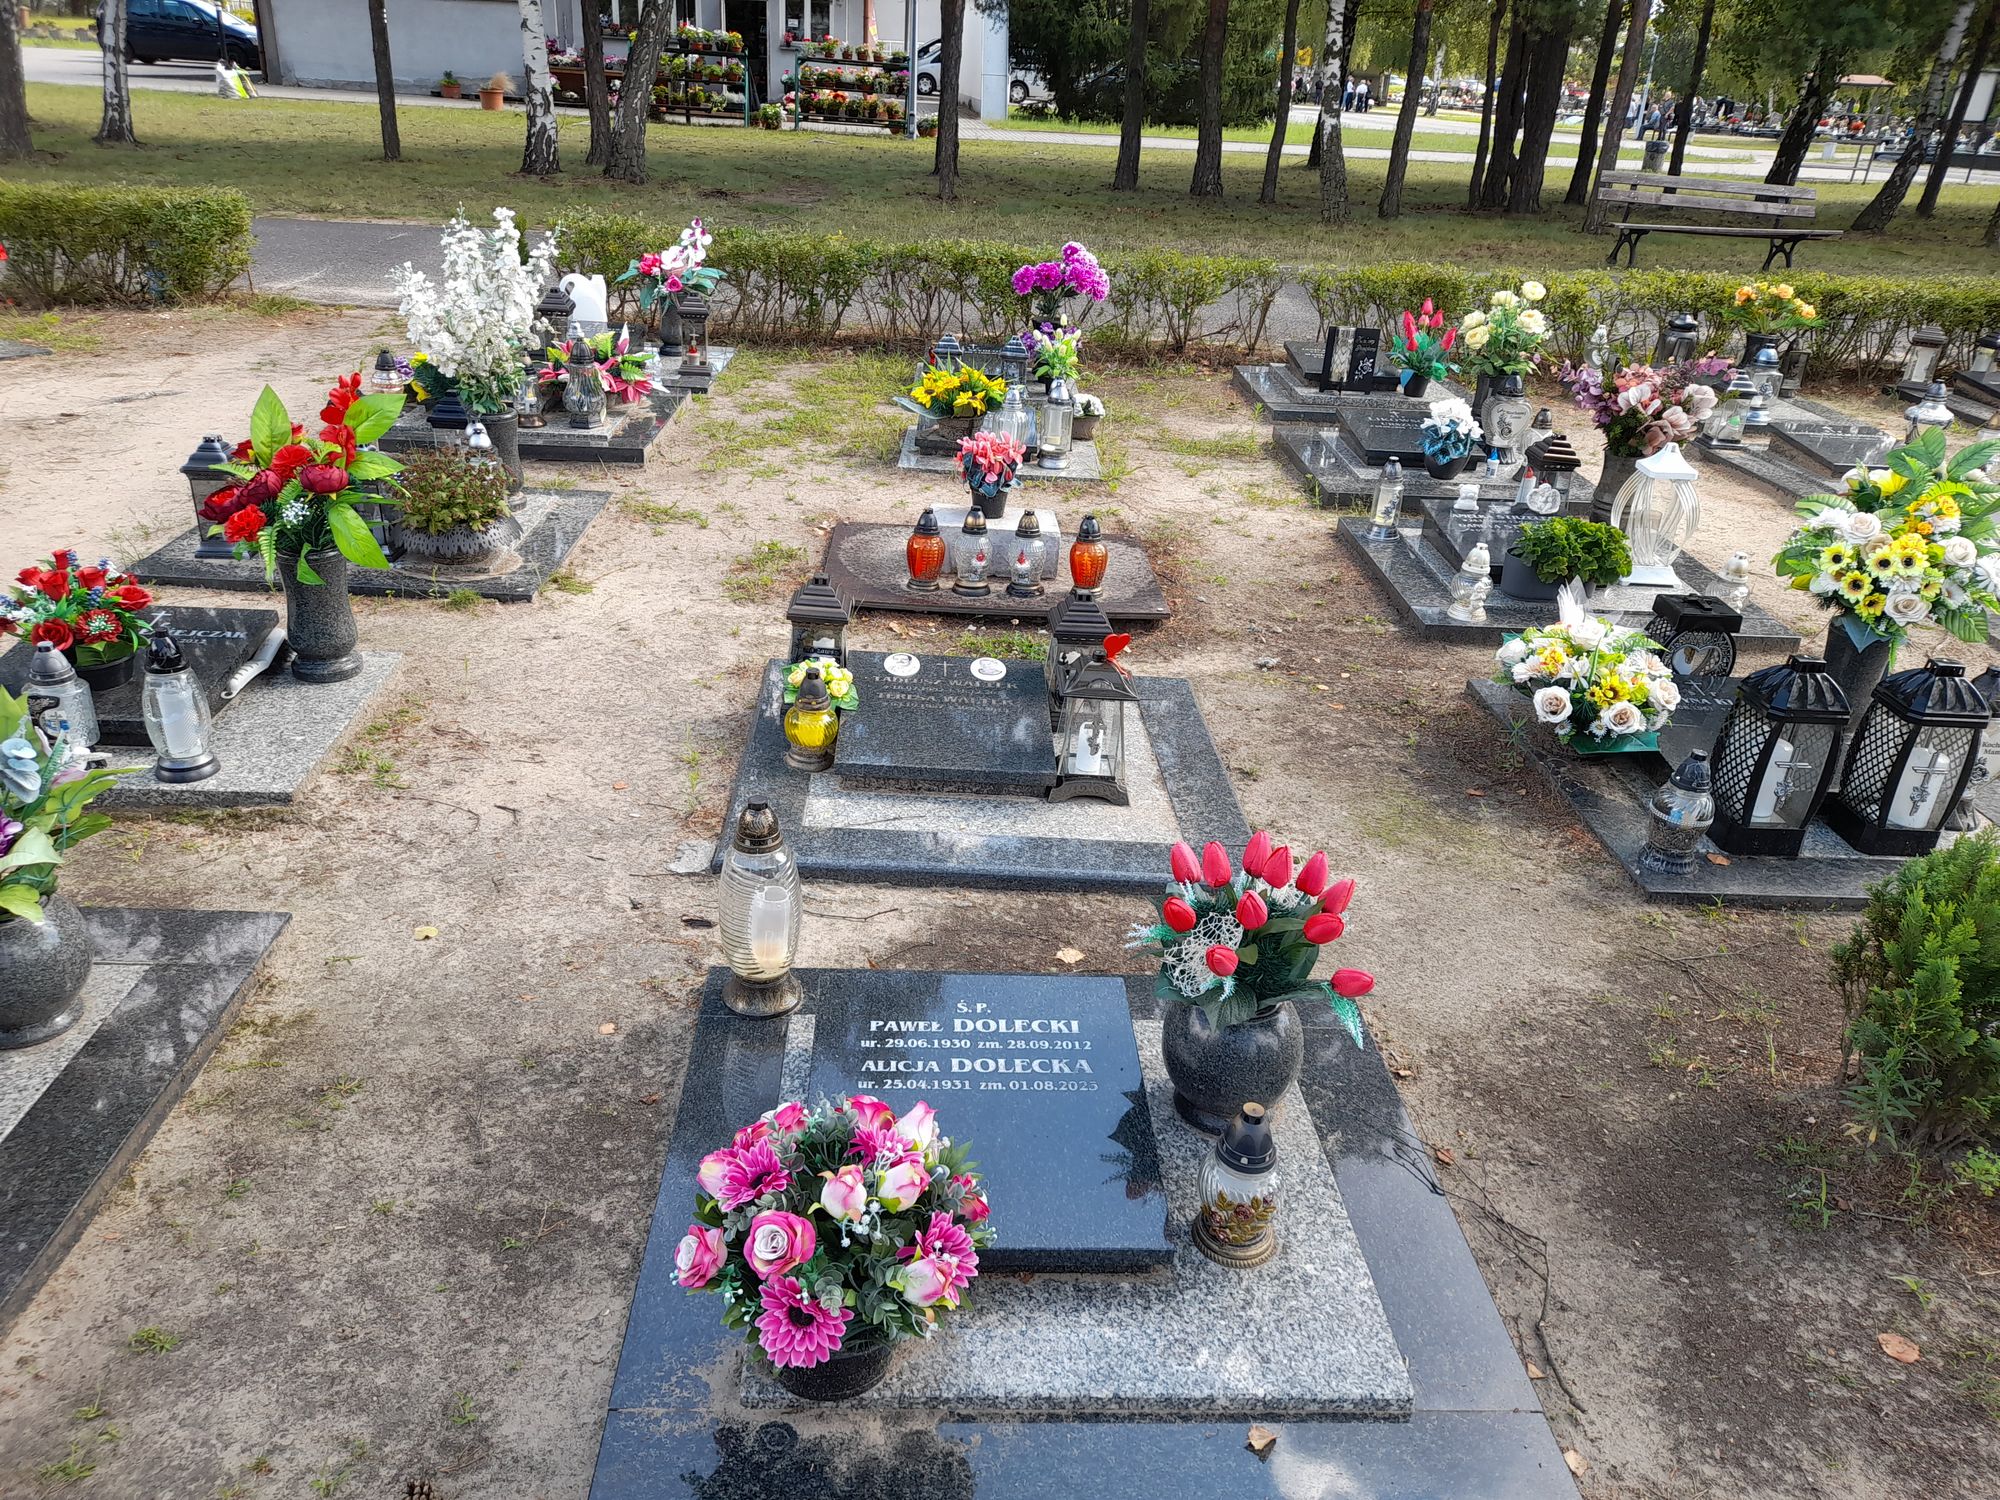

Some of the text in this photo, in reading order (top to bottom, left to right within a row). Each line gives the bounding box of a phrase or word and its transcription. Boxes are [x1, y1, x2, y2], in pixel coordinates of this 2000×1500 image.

[869, 1018, 1081, 1034] PAWEŁ DOLECKI
[860, 1038, 1092, 1050] ur. 29.06.1930 zm. 28.09.2012
[860, 1057, 1094, 1074] ALICJA DOLECKA
[857, 1080, 879, 1089] ur.
[882, 1079, 972, 1090] 25.04.1931
[979, 1081, 1006, 1090] zm.
